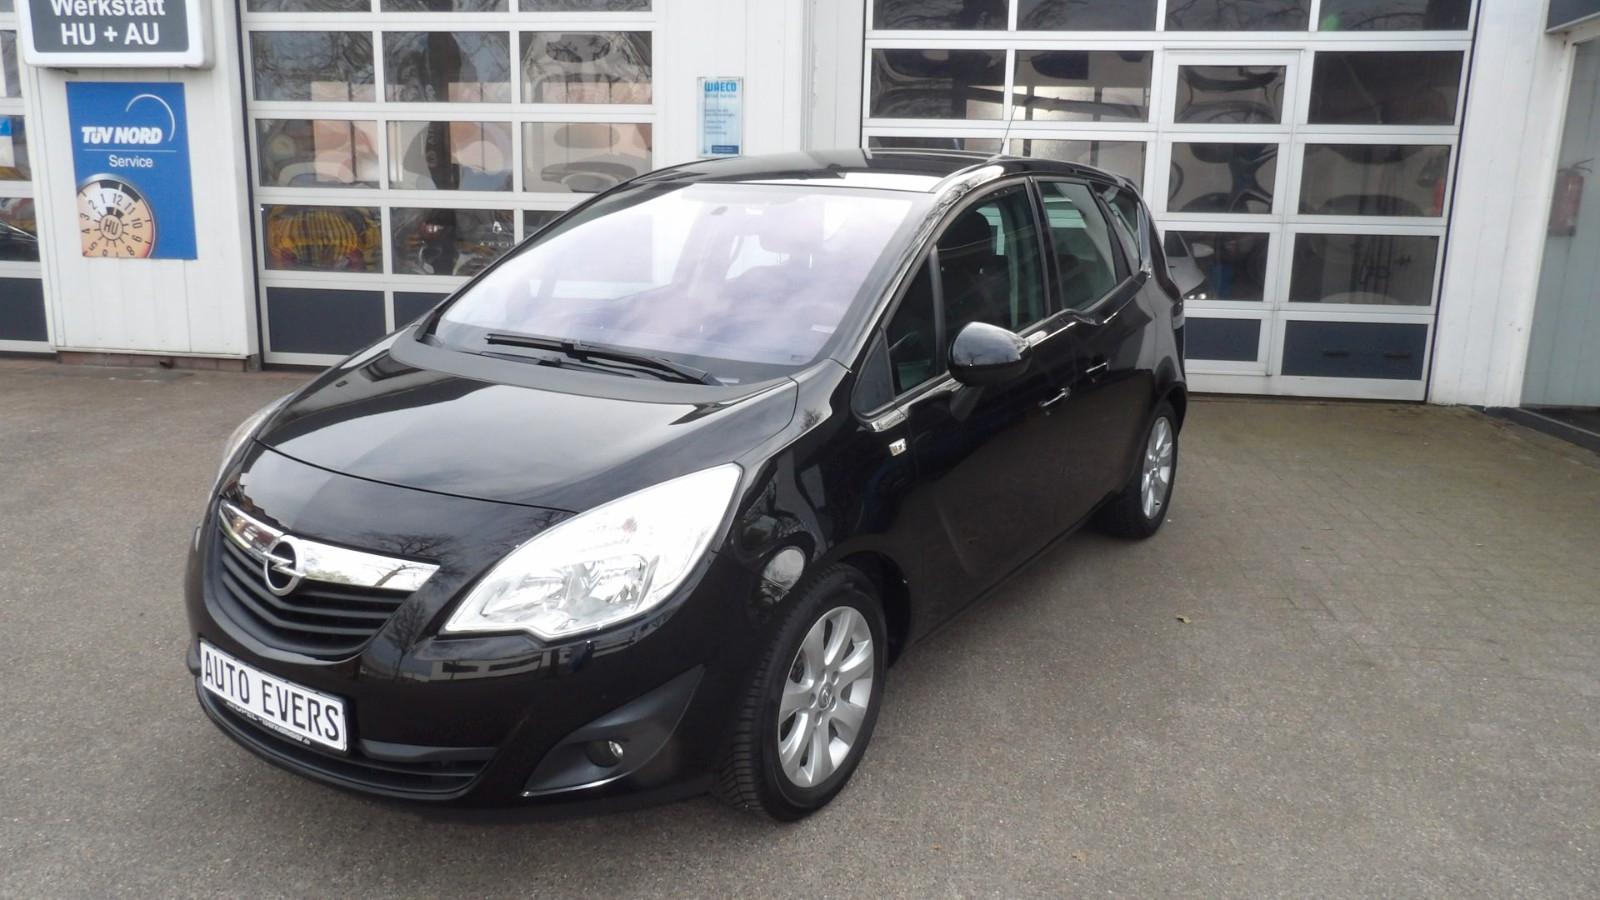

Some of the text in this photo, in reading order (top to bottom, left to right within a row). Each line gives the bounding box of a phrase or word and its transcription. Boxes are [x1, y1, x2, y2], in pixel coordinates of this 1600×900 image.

[50, 0, 166, 16] Werkstatt
[60, 22, 160, 45] HU + AU
[81, 126, 163, 145] TÜV NORD
[108, 154, 154, 168] Service
[88, 200, 97, 210] 2
[113, 193, 123, 206] 12
[124, 202, 136, 215] 11
[104, 218, 119, 235] HU
[131, 218, 143, 229] 10
[88, 241, 98, 251] 5
[126, 245, 135, 256] 8
[205, 651, 250, 704] AUTO
[262, 679, 339, 741] EVERS
